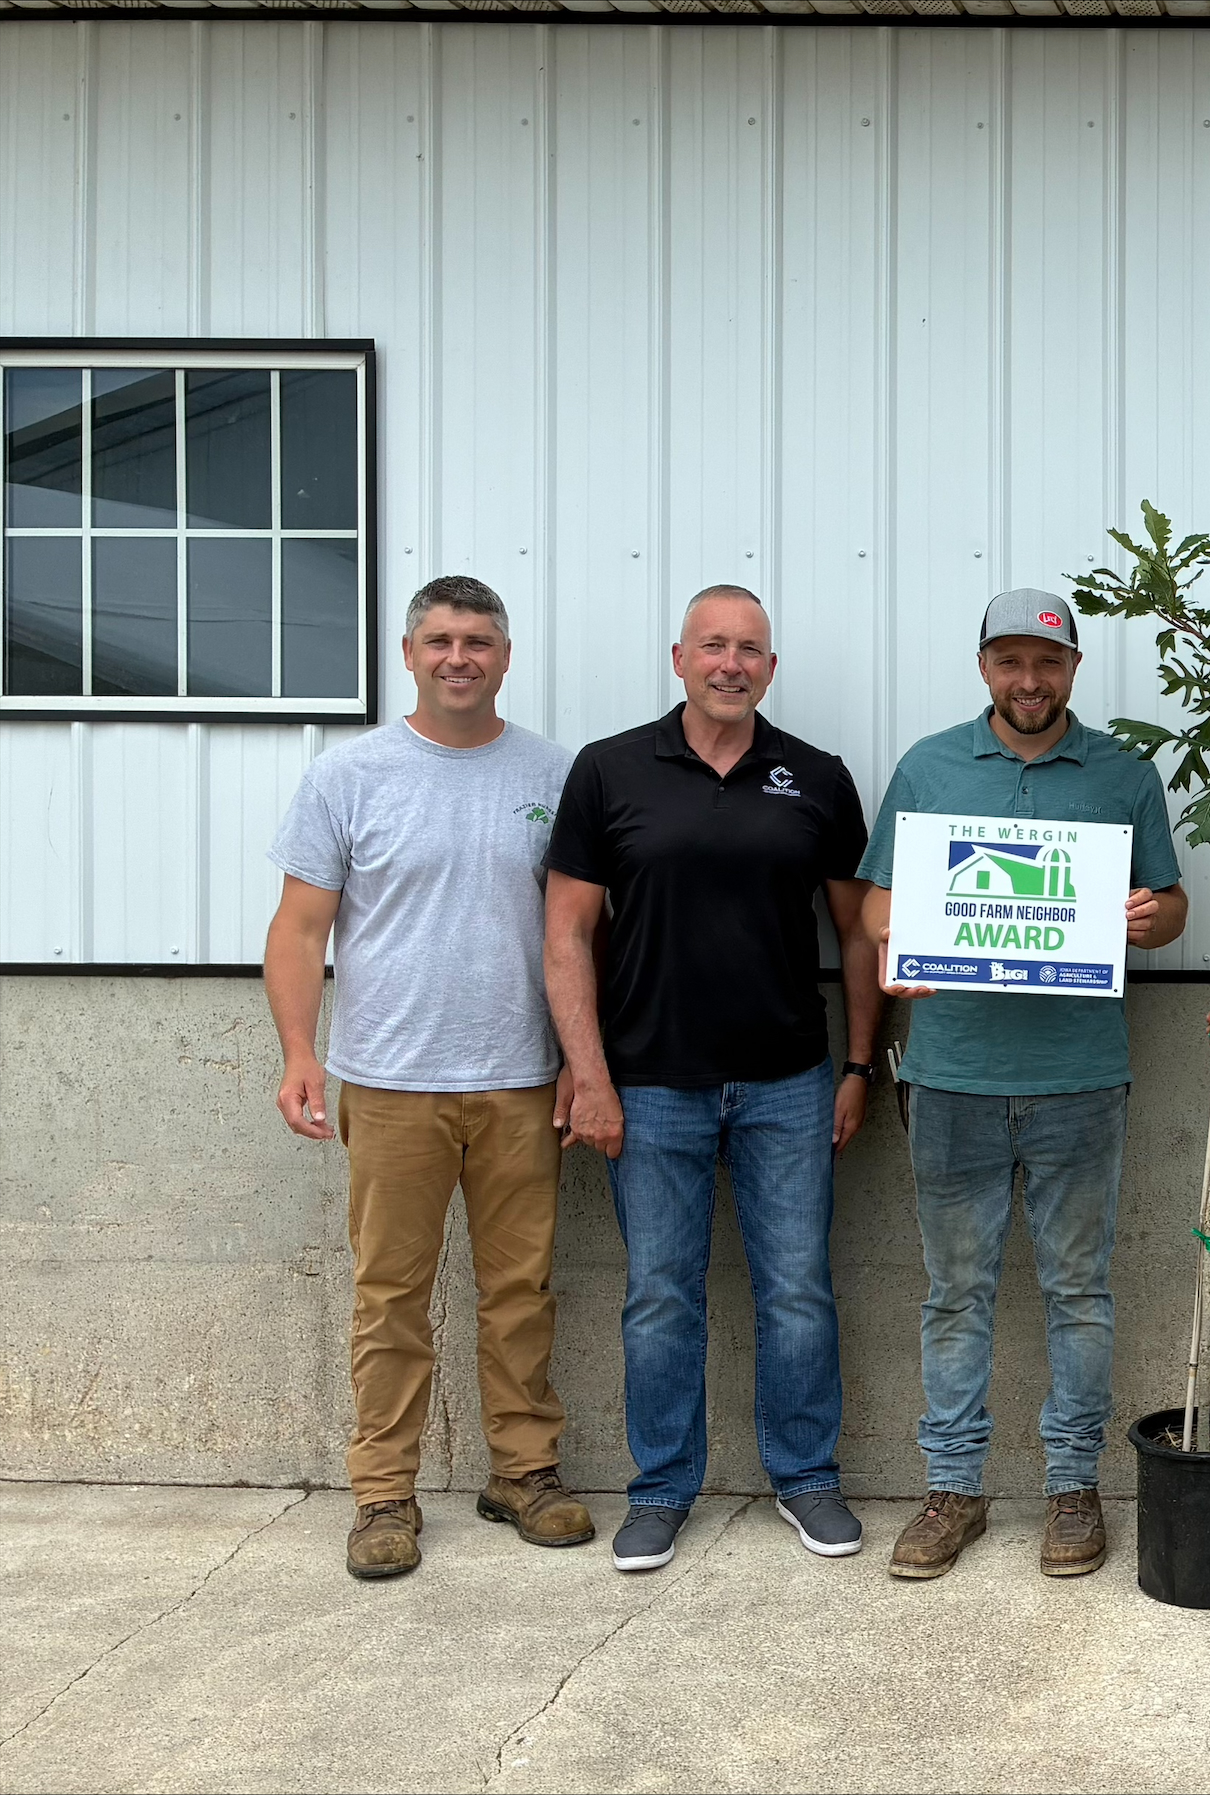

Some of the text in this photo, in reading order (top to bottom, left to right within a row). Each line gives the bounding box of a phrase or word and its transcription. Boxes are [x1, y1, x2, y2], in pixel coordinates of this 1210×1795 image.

[949, 825, 1078, 843] THE WERGIN
[945, 901, 1076, 923] GOOD FARM NEIGHBOR
[953, 922, 1065, 951] AWARD
[922, 963, 978, 973] COALITION
